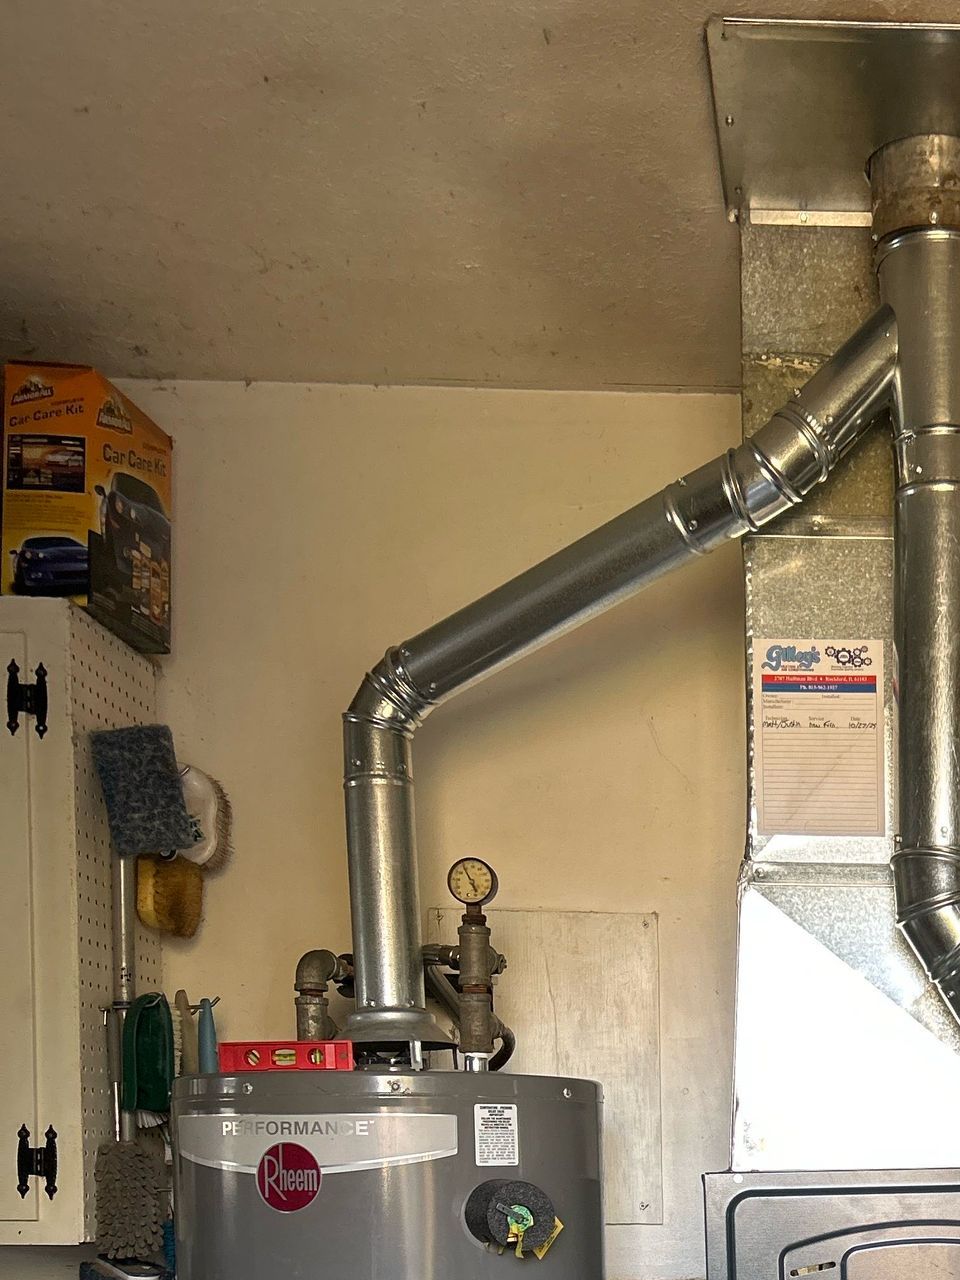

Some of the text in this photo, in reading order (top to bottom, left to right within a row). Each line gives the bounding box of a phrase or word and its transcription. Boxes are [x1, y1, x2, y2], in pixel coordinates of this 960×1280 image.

[9, 404, 84, 427] Car Care Kit
[102, 443, 166, 477] Car Care Kit
[264, 1144, 318, 1201] Rheem
